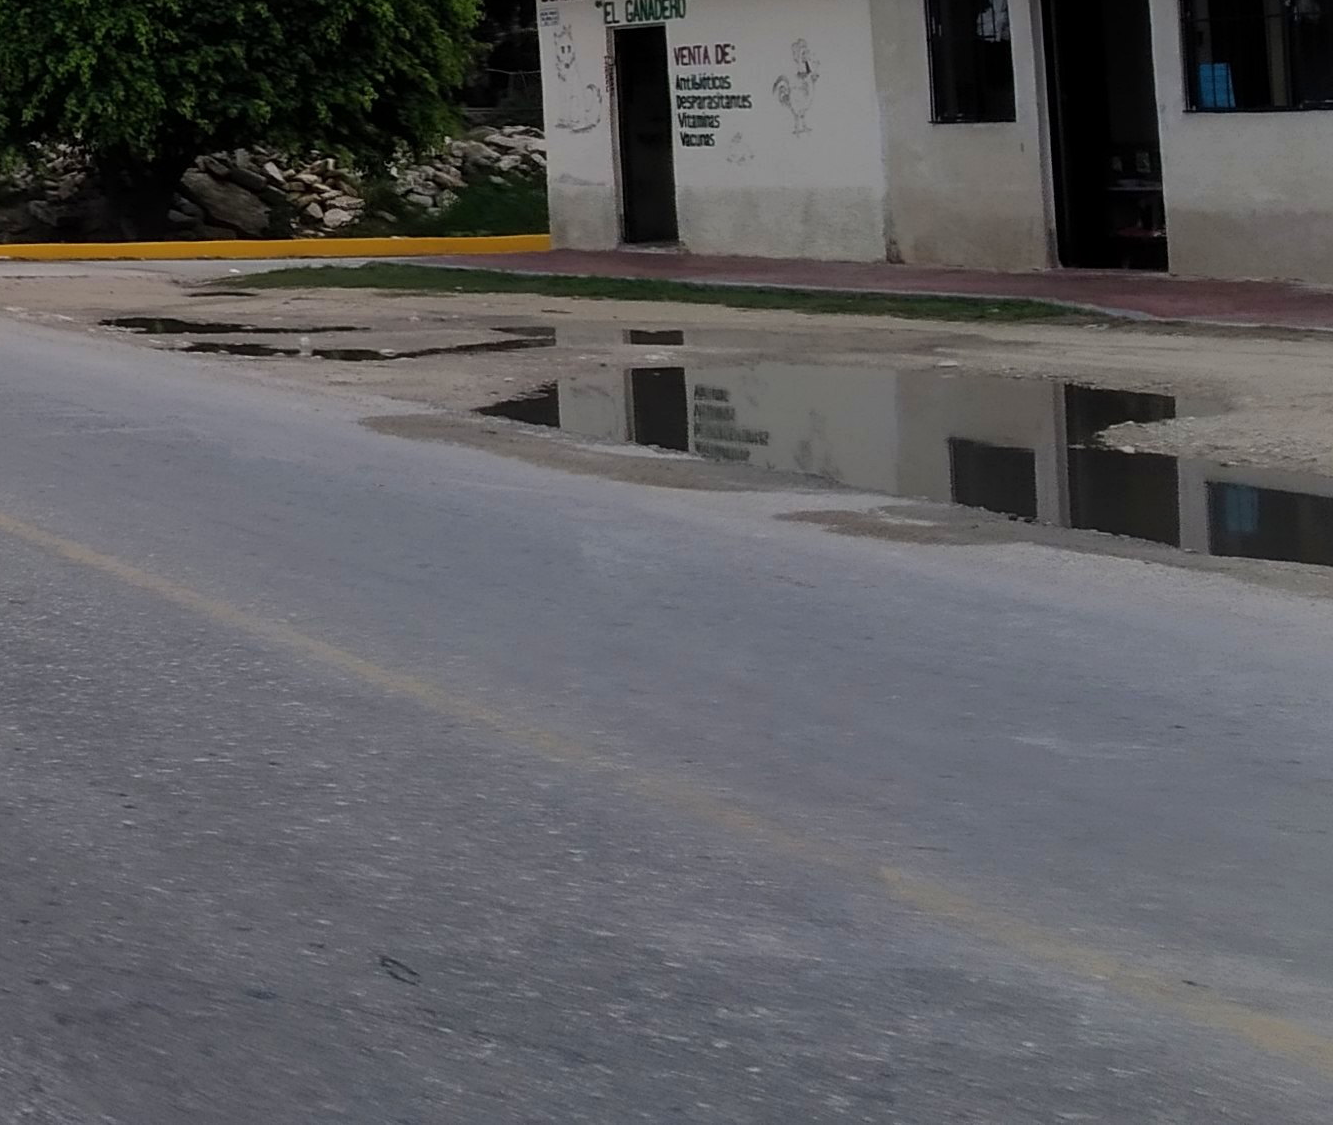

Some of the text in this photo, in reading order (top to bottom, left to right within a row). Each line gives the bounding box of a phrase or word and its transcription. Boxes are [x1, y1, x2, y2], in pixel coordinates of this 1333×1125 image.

[673, 43, 736, 66] VENTA DE:
[677, 112, 720, 128] Vitaminas
[680, 131, 715, 147] Vacunas
